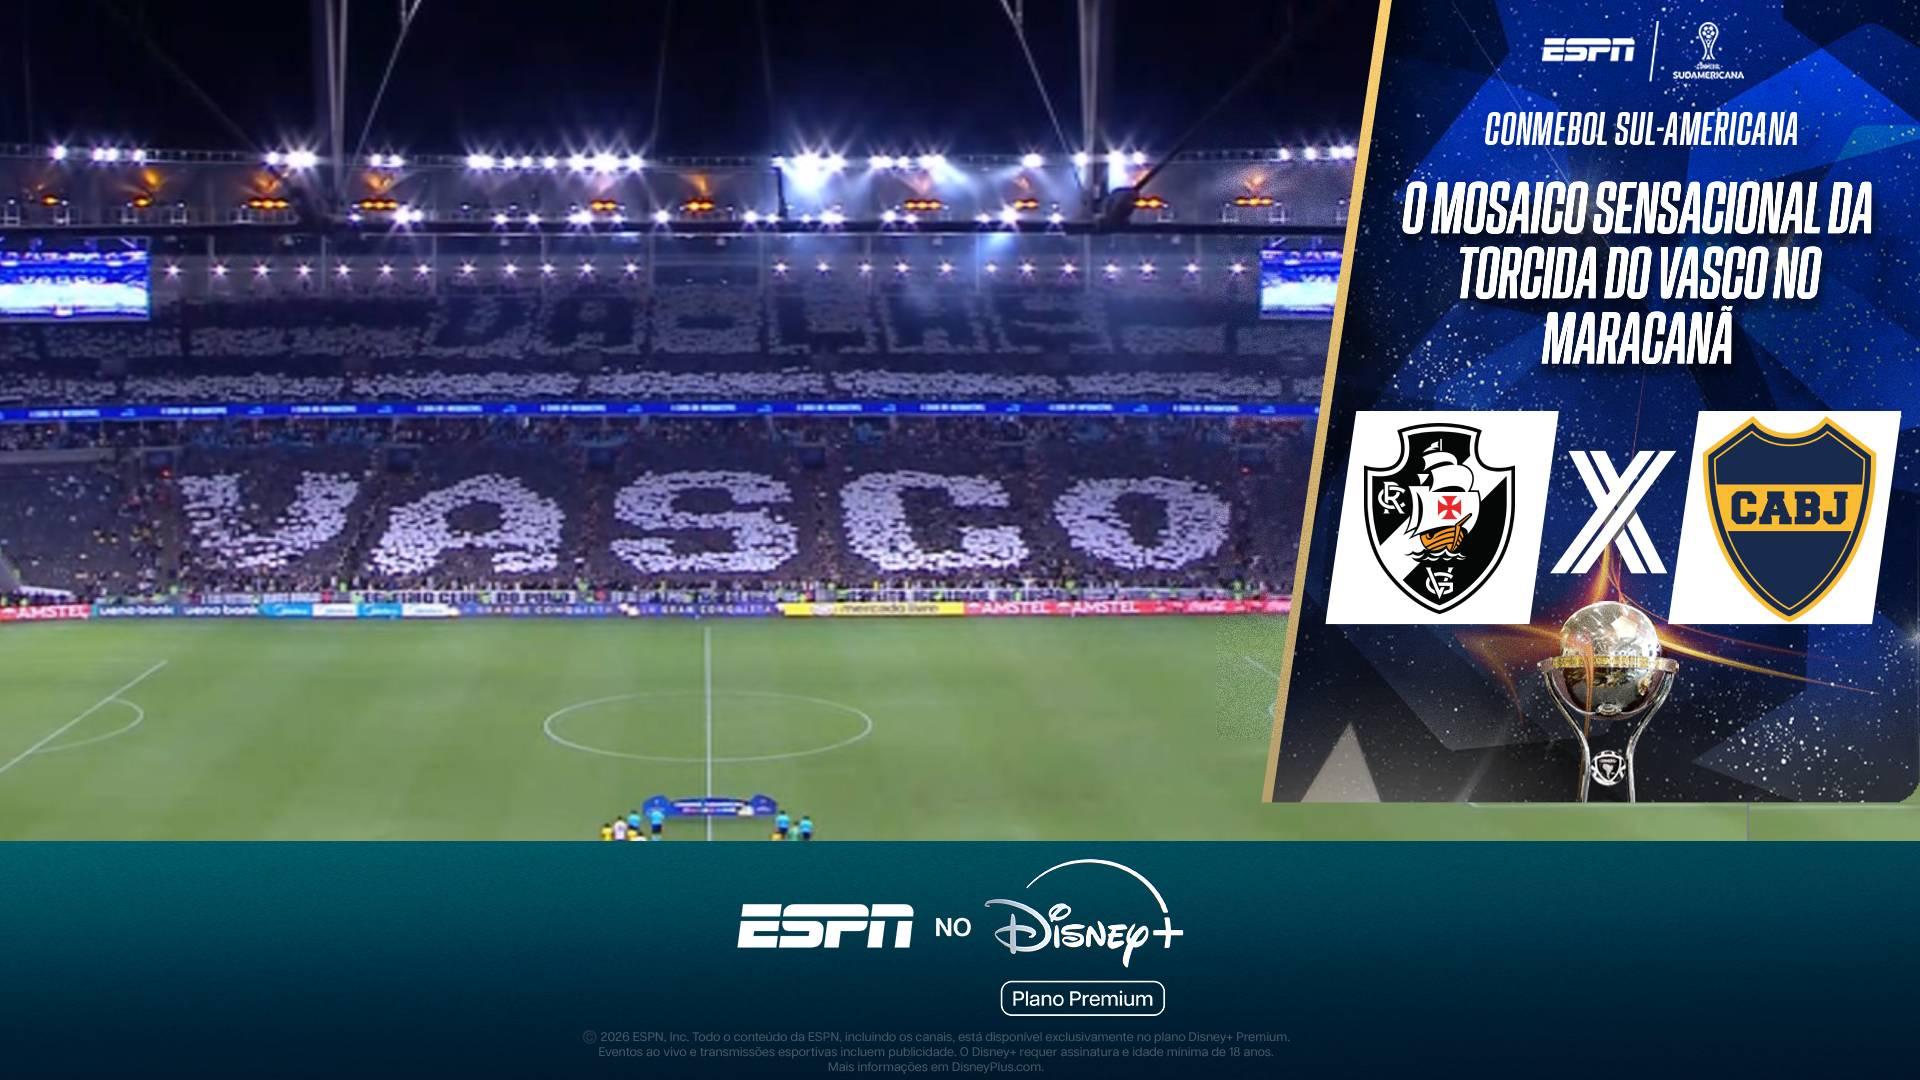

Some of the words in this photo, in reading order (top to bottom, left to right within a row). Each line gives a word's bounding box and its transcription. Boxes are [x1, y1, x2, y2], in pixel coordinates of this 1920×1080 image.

[178, 470, 1232, 574] VASCO
[16, 604, 89, 620] AMSTEL
[99, 604, 135, 616] ueno
[136, 604, 174, 616] bank
[183, 604, 221, 616] ueno
[223, 604, 258, 616] bank
[841, 603, 905, 614] mercado
[981, 601, 1049, 614] AMSTEL
[1071, 601, 1140, 614] AMSTEL
